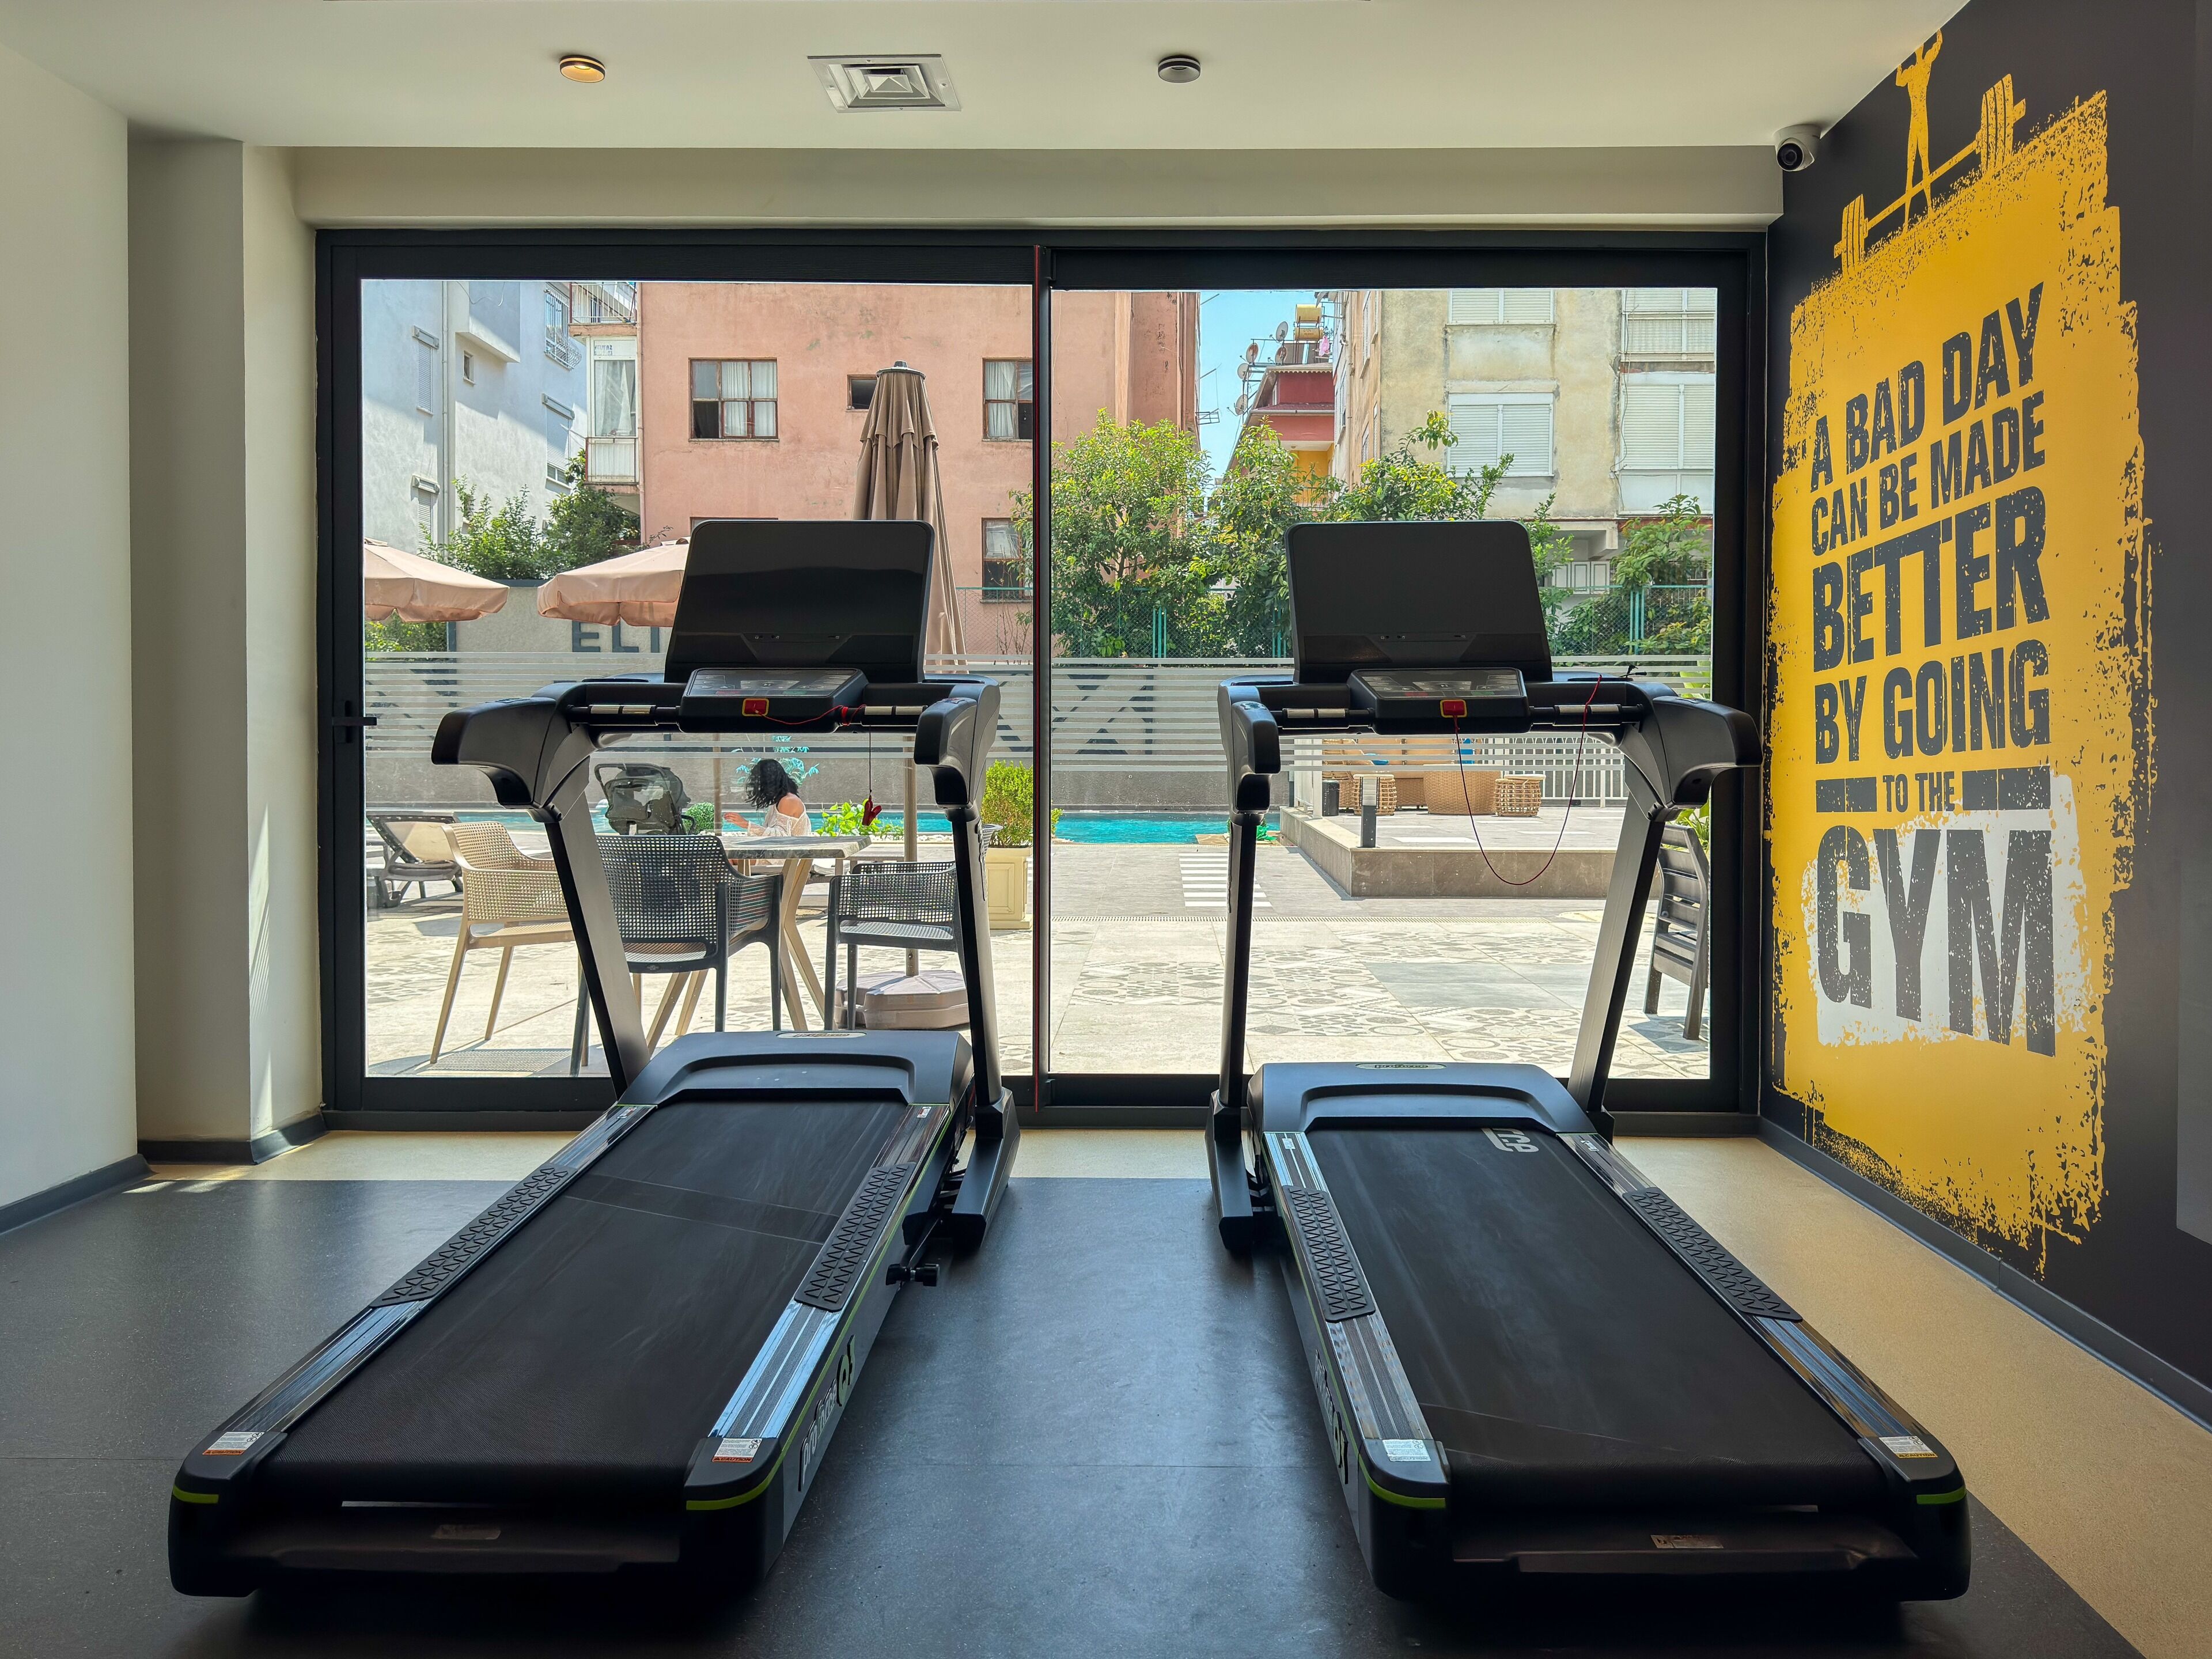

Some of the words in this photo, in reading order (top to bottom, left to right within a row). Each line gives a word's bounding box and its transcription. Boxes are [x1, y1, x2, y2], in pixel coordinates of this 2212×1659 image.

[1810, 414, 1834, 493] A
[1846, 359, 1926, 475] BAD
[1942, 281, 2044, 426] DAY
[1811, 476, 1868, 557] CAN
[1879, 456, 1918, 531] BE
[1930, 389, 2046, 510] MADE
[1813, 486, 2051, 672] BETTER
[1815, 675, 1868, 764] BY
[1883, 639, 2051, 759] GOING
[1882, 774, 1908, 813] TO
[1914, 771, 1955, 812] THE
[1817, 825, 2056, 1058] GYM
